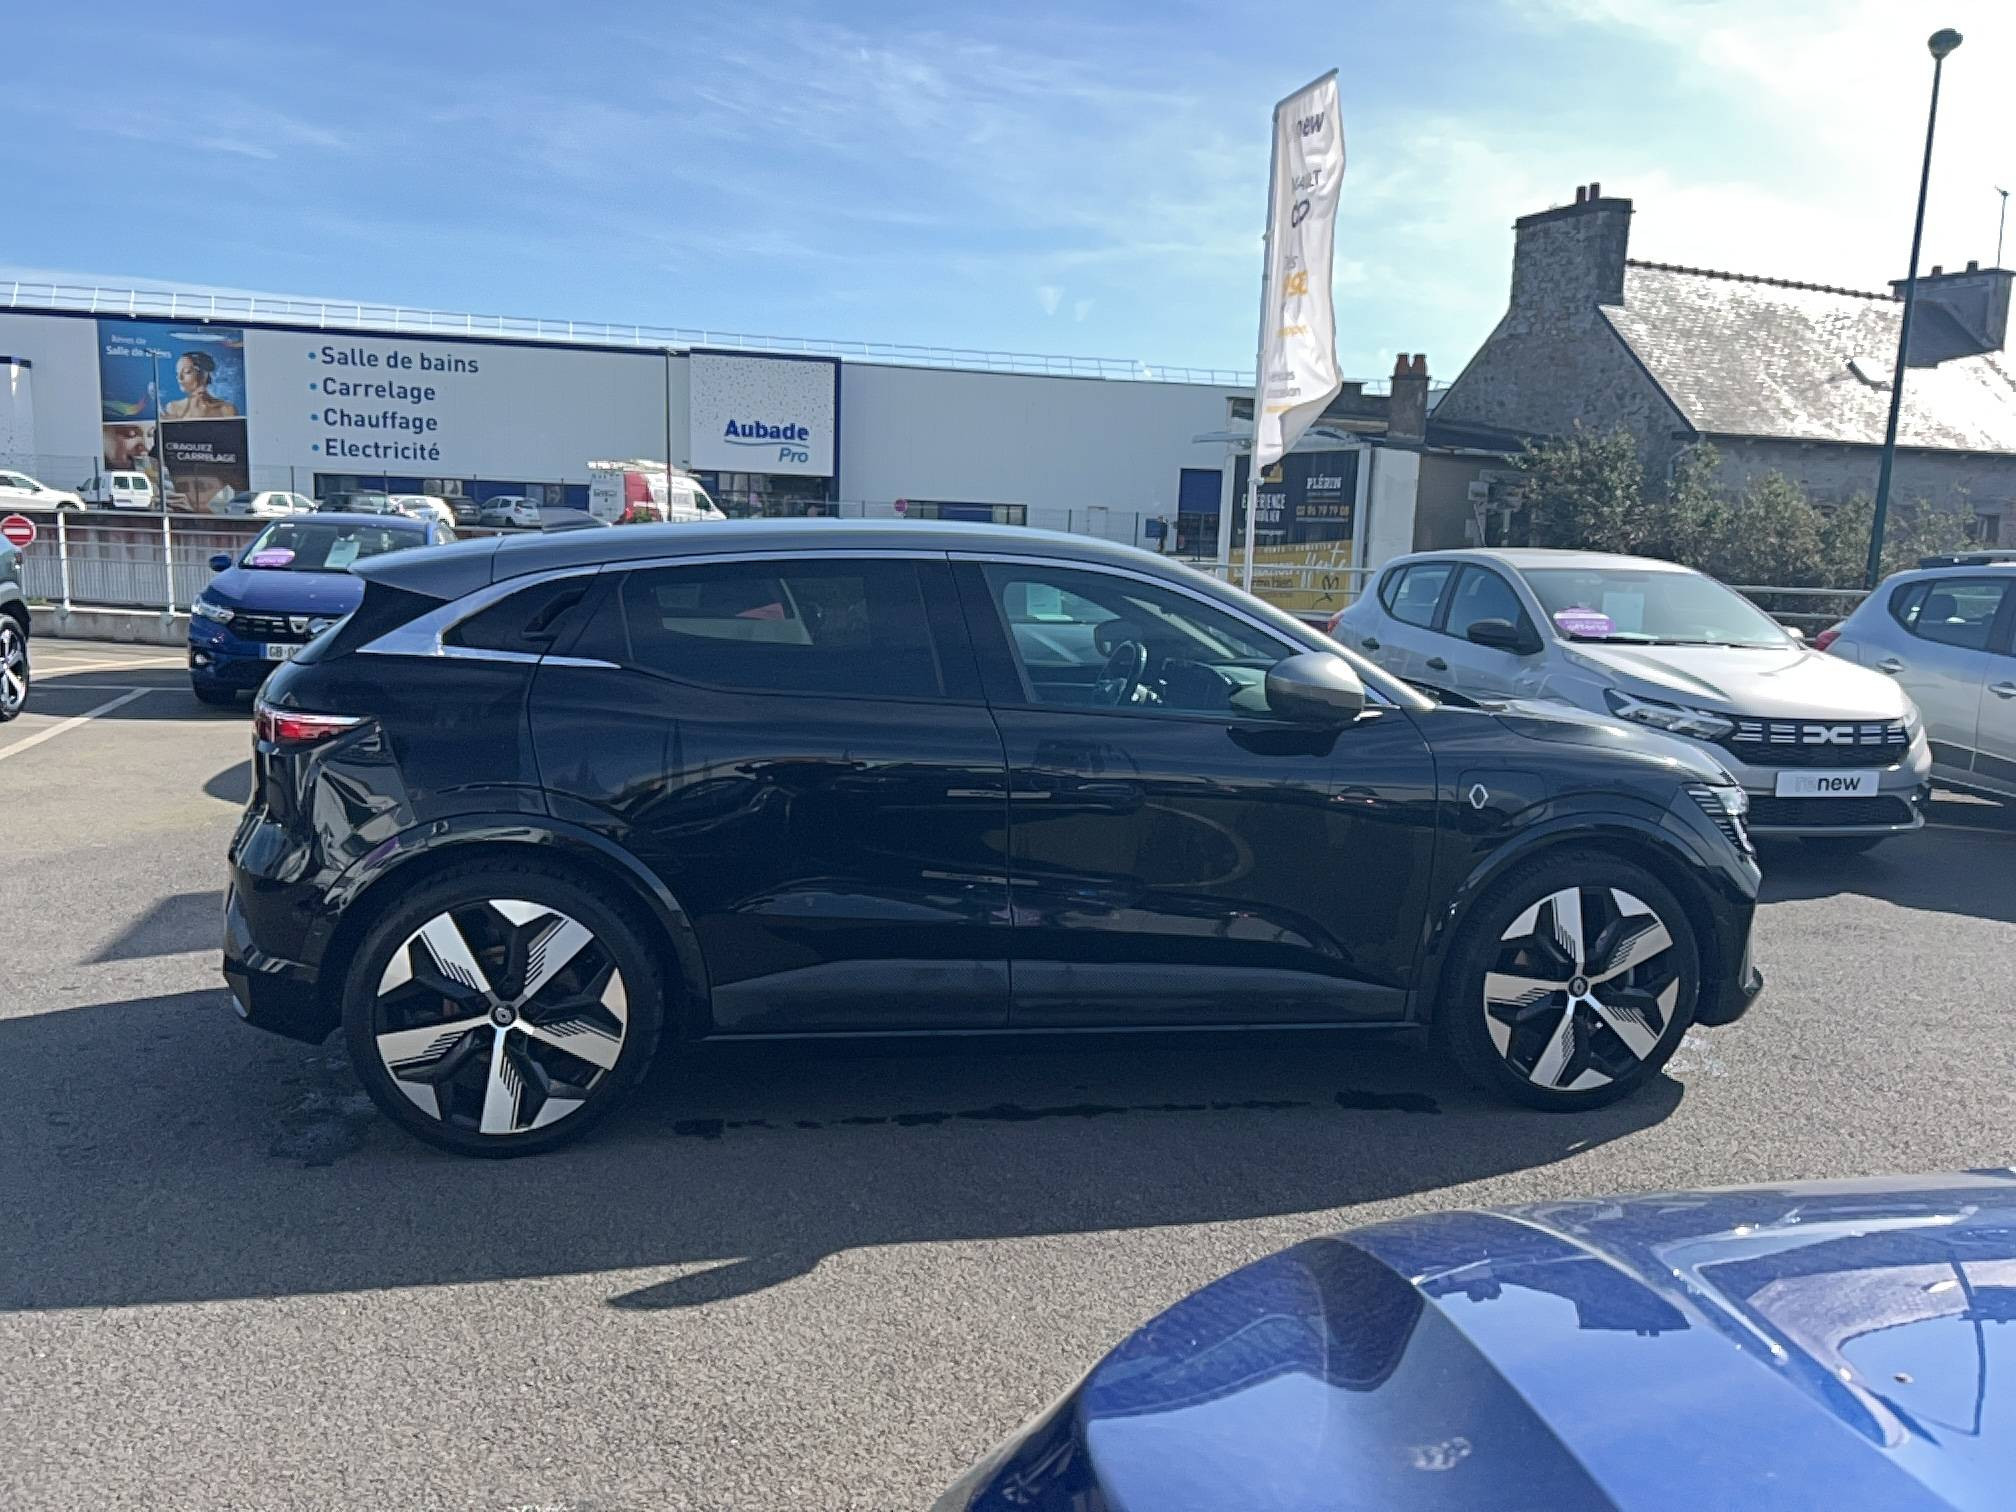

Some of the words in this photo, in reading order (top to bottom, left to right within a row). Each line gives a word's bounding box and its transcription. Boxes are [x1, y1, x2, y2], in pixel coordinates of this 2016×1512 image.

[105, 345, 130, 357] Salle
[321, 346, 379, 367] Salle
[386, 350, 413, 369] de
[420, 352, 479, 373] bains
[322, 377, 436, 404] Carrelage
[323, 408, 438, 434] Chauffage
[724, 419, 809, 441] Aubade
[166, 442, 213, 451] CRAQUEZ
[325, 438, 440, 461] Electricité
[778, 447, 809, 463] Pro
[177, 451, 237, 463] CARRELAGE
[1306, 473, 1342, 490] PLÉRIN
